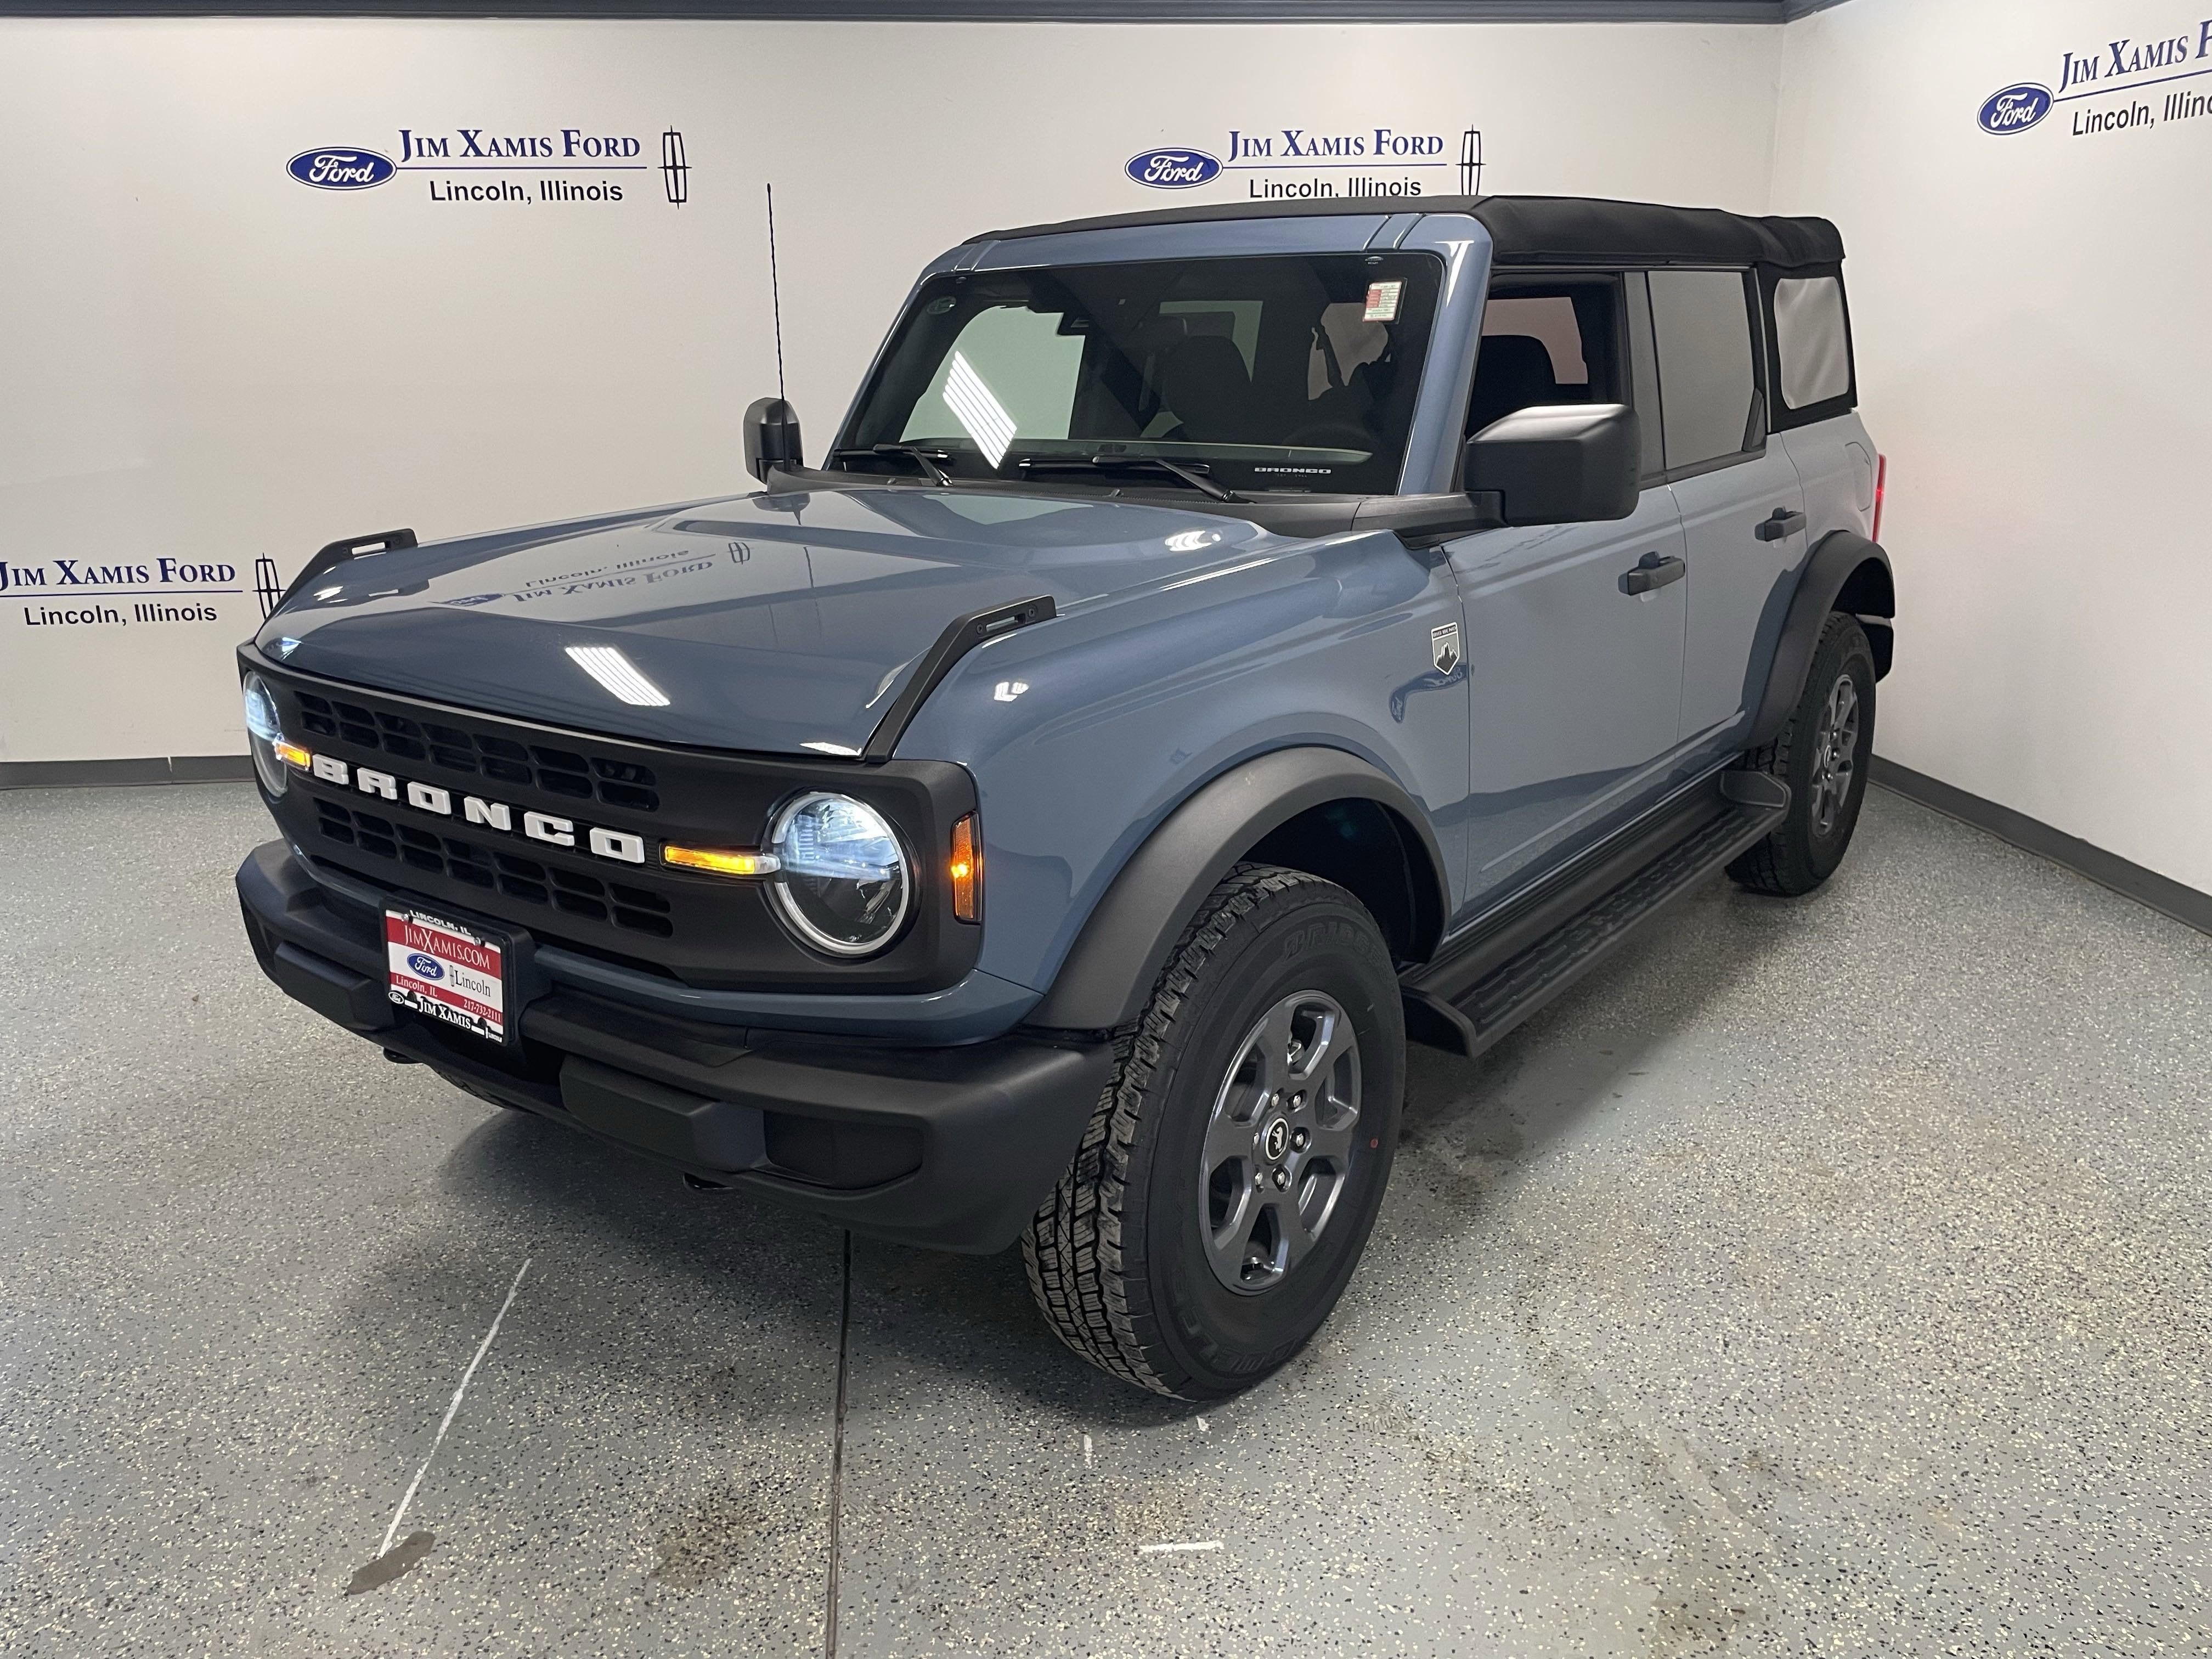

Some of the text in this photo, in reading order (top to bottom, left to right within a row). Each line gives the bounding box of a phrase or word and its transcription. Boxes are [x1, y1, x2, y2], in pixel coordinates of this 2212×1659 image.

[2058, 52, 2100, 93] JIM
[2104, 36, 2189, 78] XAMIS
[1989, 92, 2039, 129] Ford
[2072, 100, 2155, 136] Lincoln,
[398, 129, 640, 162] JIM XAMIS FORD
[1228, 129, 1444, 162] JIM XAMIS FORD
[308, 153, 375, 183] Ford
[1143, 155, 1204, 183] Ford
[430, 180, 624, 205] Lincoln, Illinois
[1249, 177, 1421, 198] Lincoln, Illinois
[0, 558, 236, 591] JIM XAMIS FORD
[24, 602, 217, 627] Lincoln, Illinois
[313, 754, 646, 864] BRONCO
[460, 926, 472, 936] IL
[415, 956, 438, 977] Ford
[396, 975, 438, 997] Lincoln, IL
[455, 969, 491, 997] Lincoln
[419, 998, 472, 1029] JIM XAMIS
[463, 998, 502, 1022] 217-732-2111
